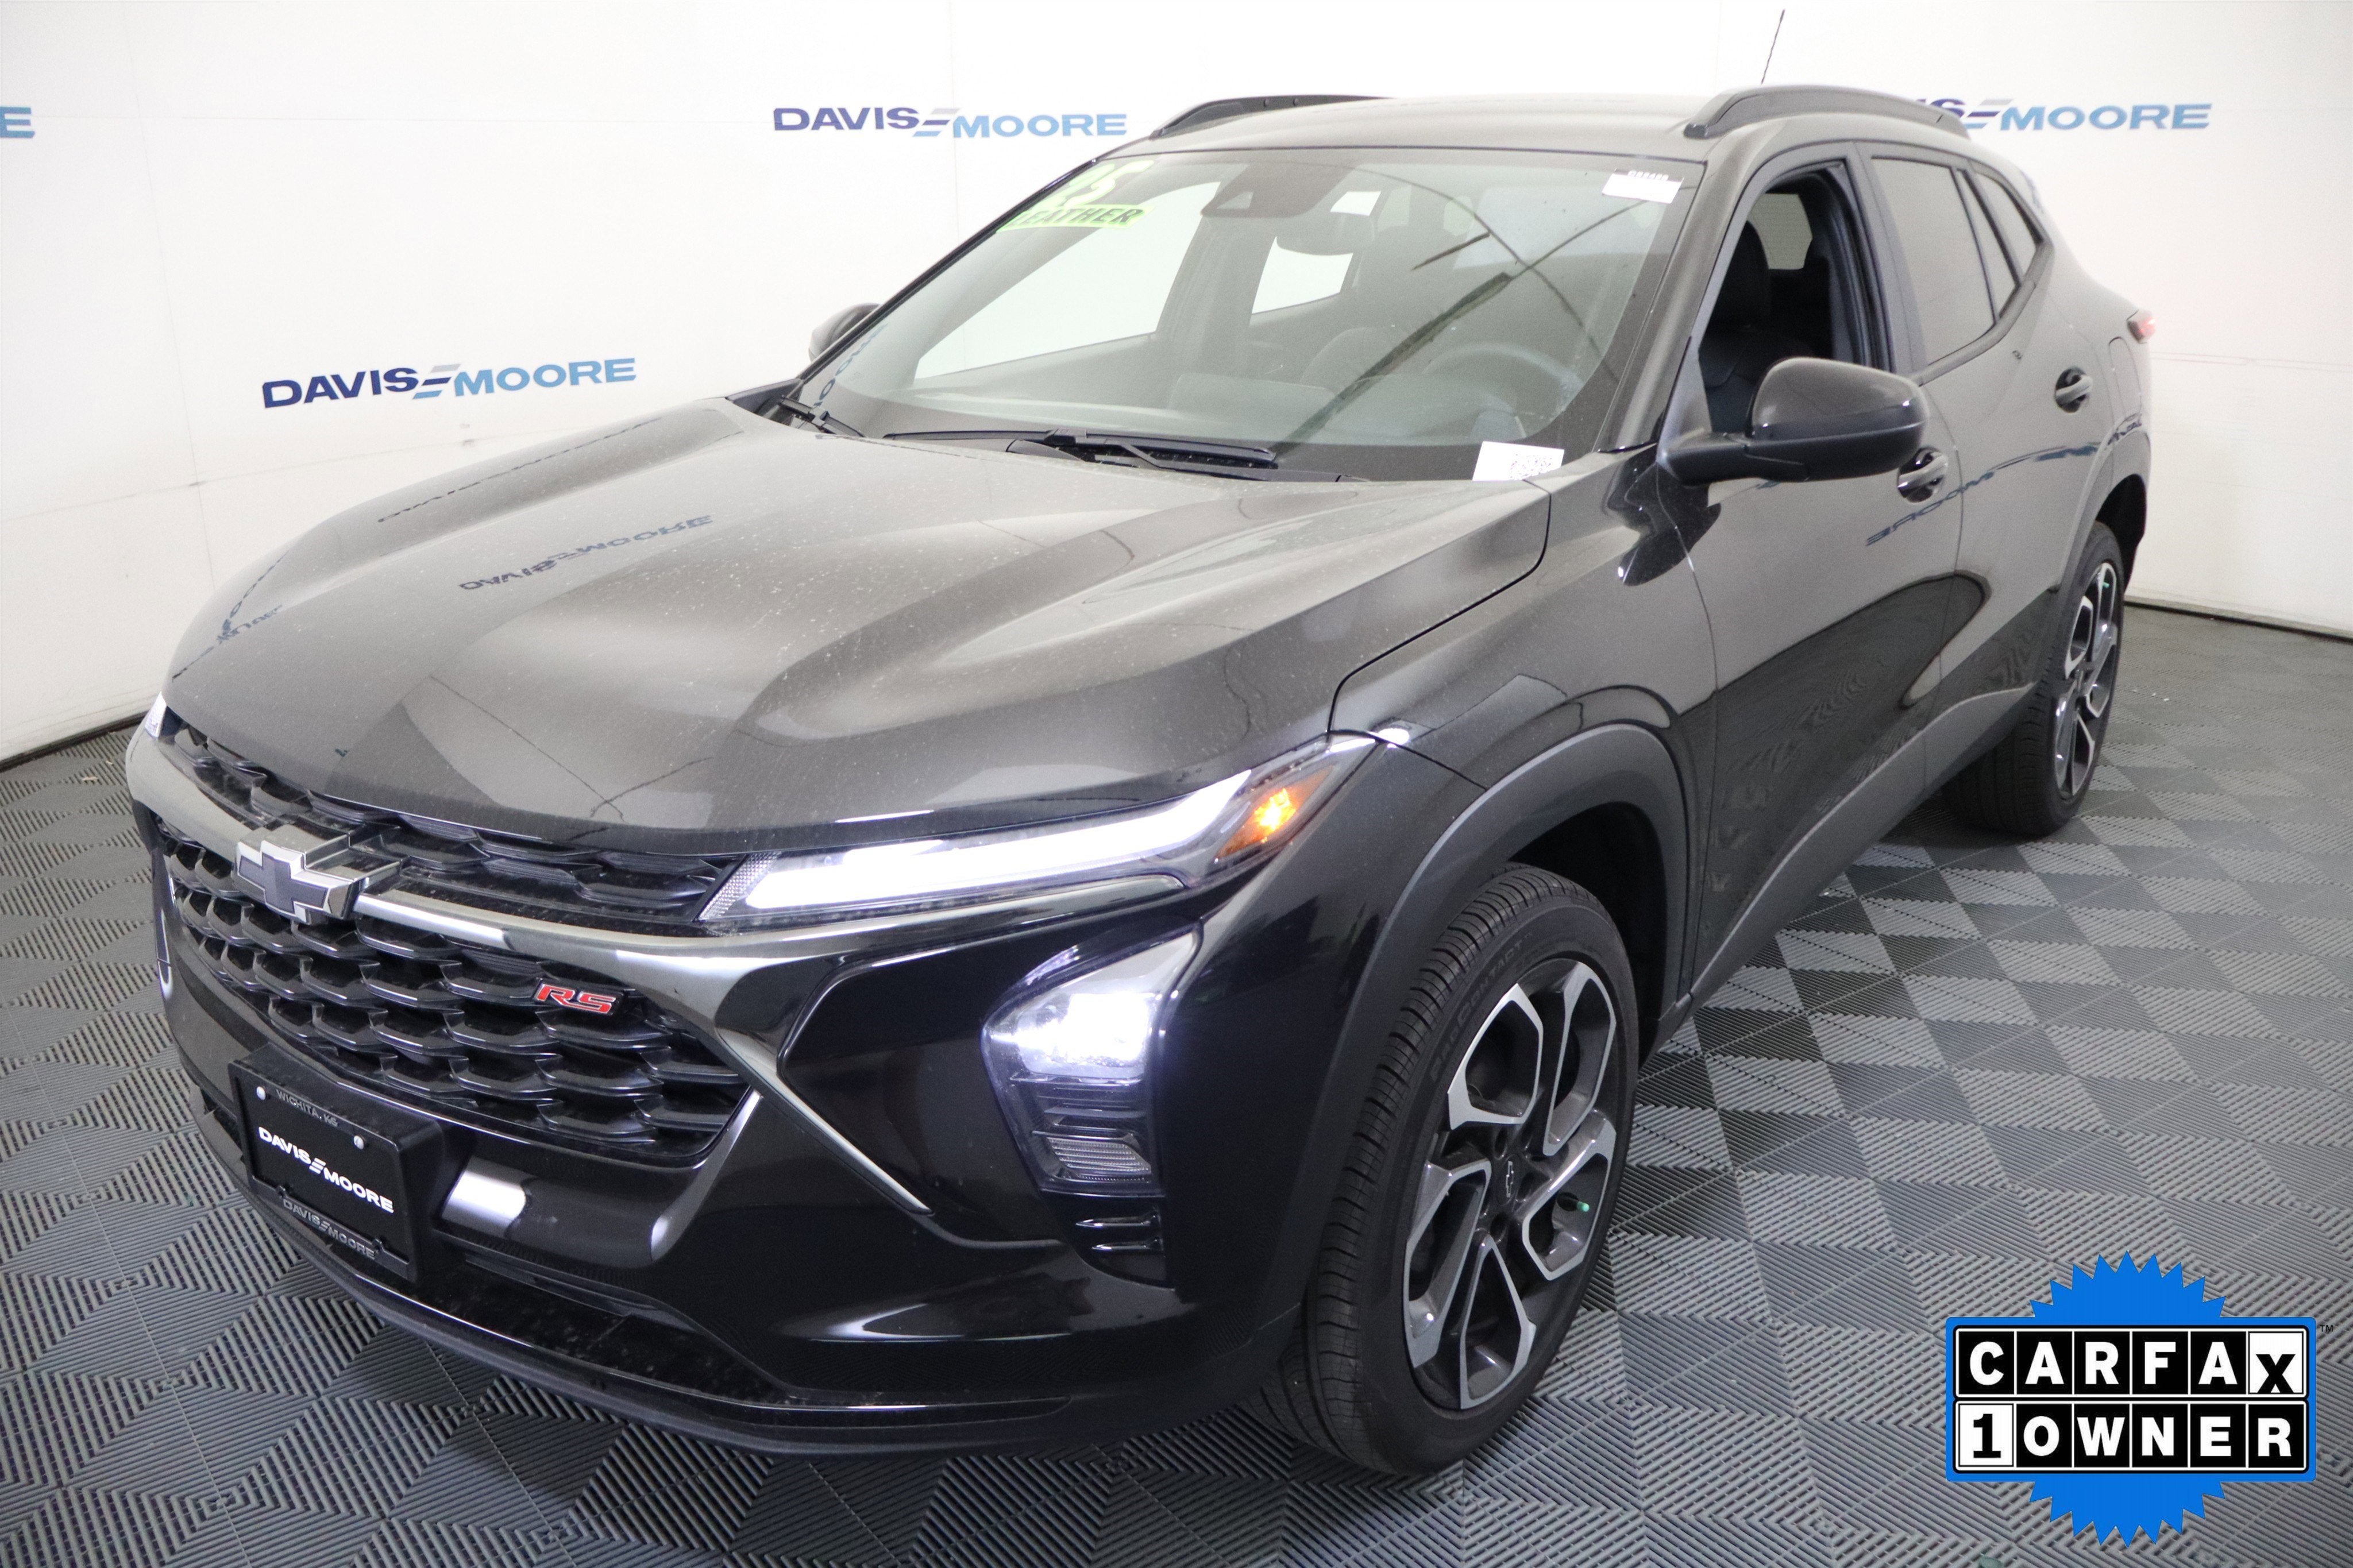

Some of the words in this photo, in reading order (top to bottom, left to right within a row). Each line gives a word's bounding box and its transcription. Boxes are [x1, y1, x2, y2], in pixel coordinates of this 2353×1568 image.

[773, 107, 920, 131] DAVIS
[954, 114, 1127, 138] MOORE
[2000, 103, 2212, 131] MOORE
[1008, 208, 1145, 225] LEATHER
[262, 368, 419, 408] DAVIS
[454, 358, 637, 397] MOORE
[534, 983, 616, 1014] RS
[259, 1126, 313, 1165] DAVIS
[323, 1167, 395, 1213] MOORE
[283, 1198, 321, 1226] DAVIS
[327, 1228, 376, 1260] MOORE
